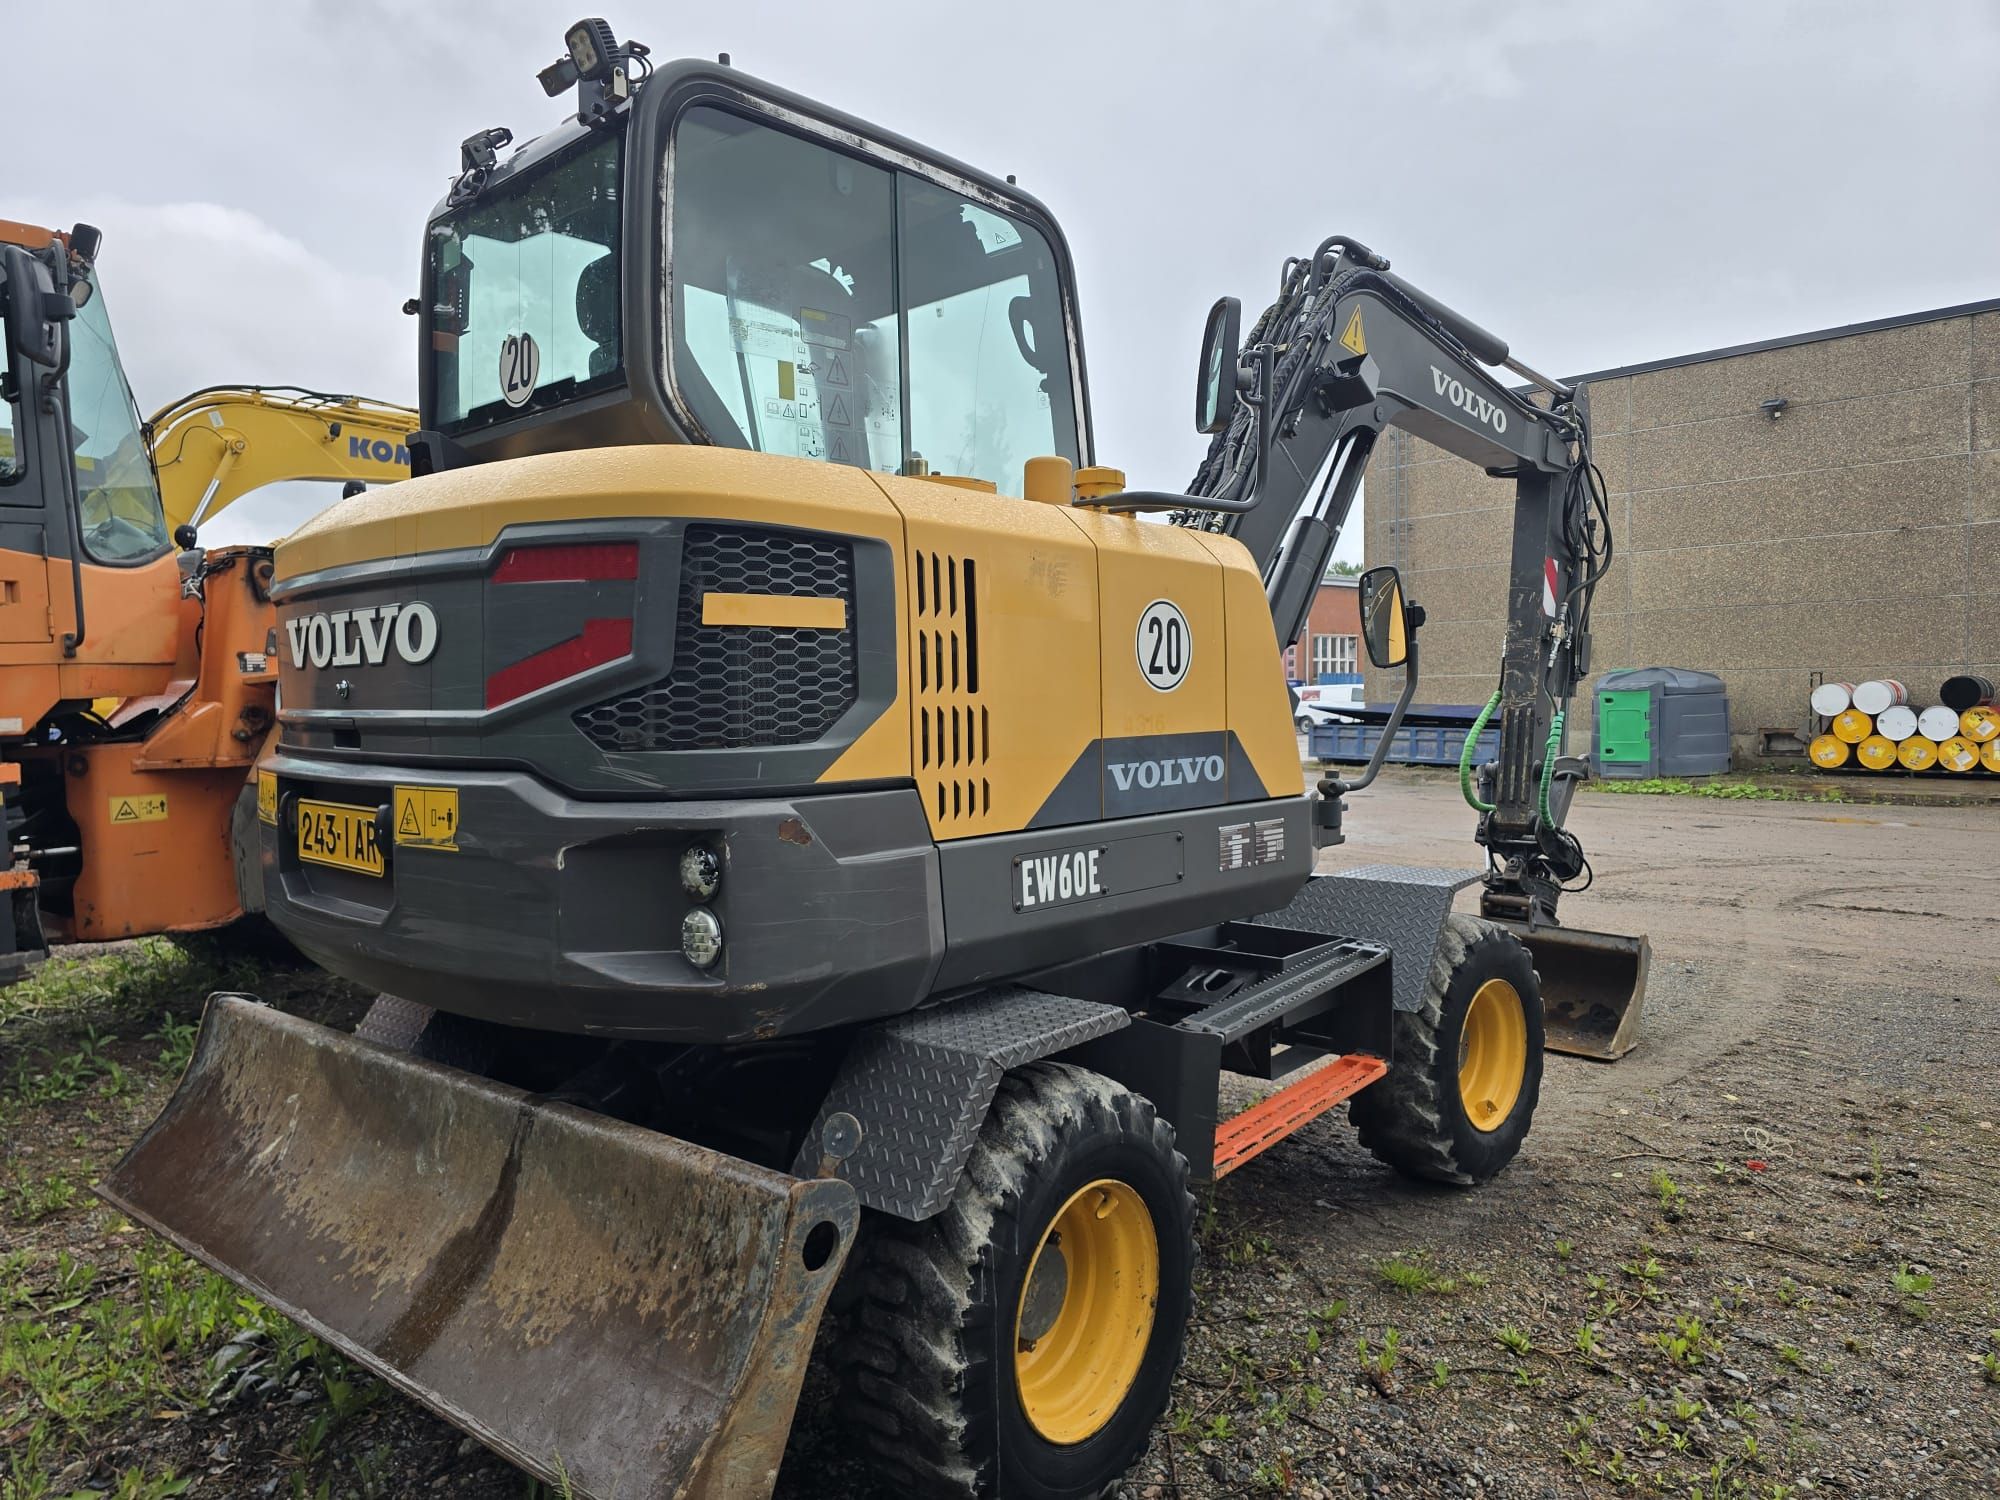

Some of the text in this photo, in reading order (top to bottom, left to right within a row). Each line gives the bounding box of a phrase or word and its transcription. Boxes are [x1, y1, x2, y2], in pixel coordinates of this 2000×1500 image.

[507, 332, 532, 393] 20
[1430, 364, 1507, 434] VOLVO
[285, 602, 438, 668] VOLVO
[1148, 616, 1181, 675] 20
[1107, 755, 1225, 791] VOLVO
[1022, 849, 1101, 907] EW60E
